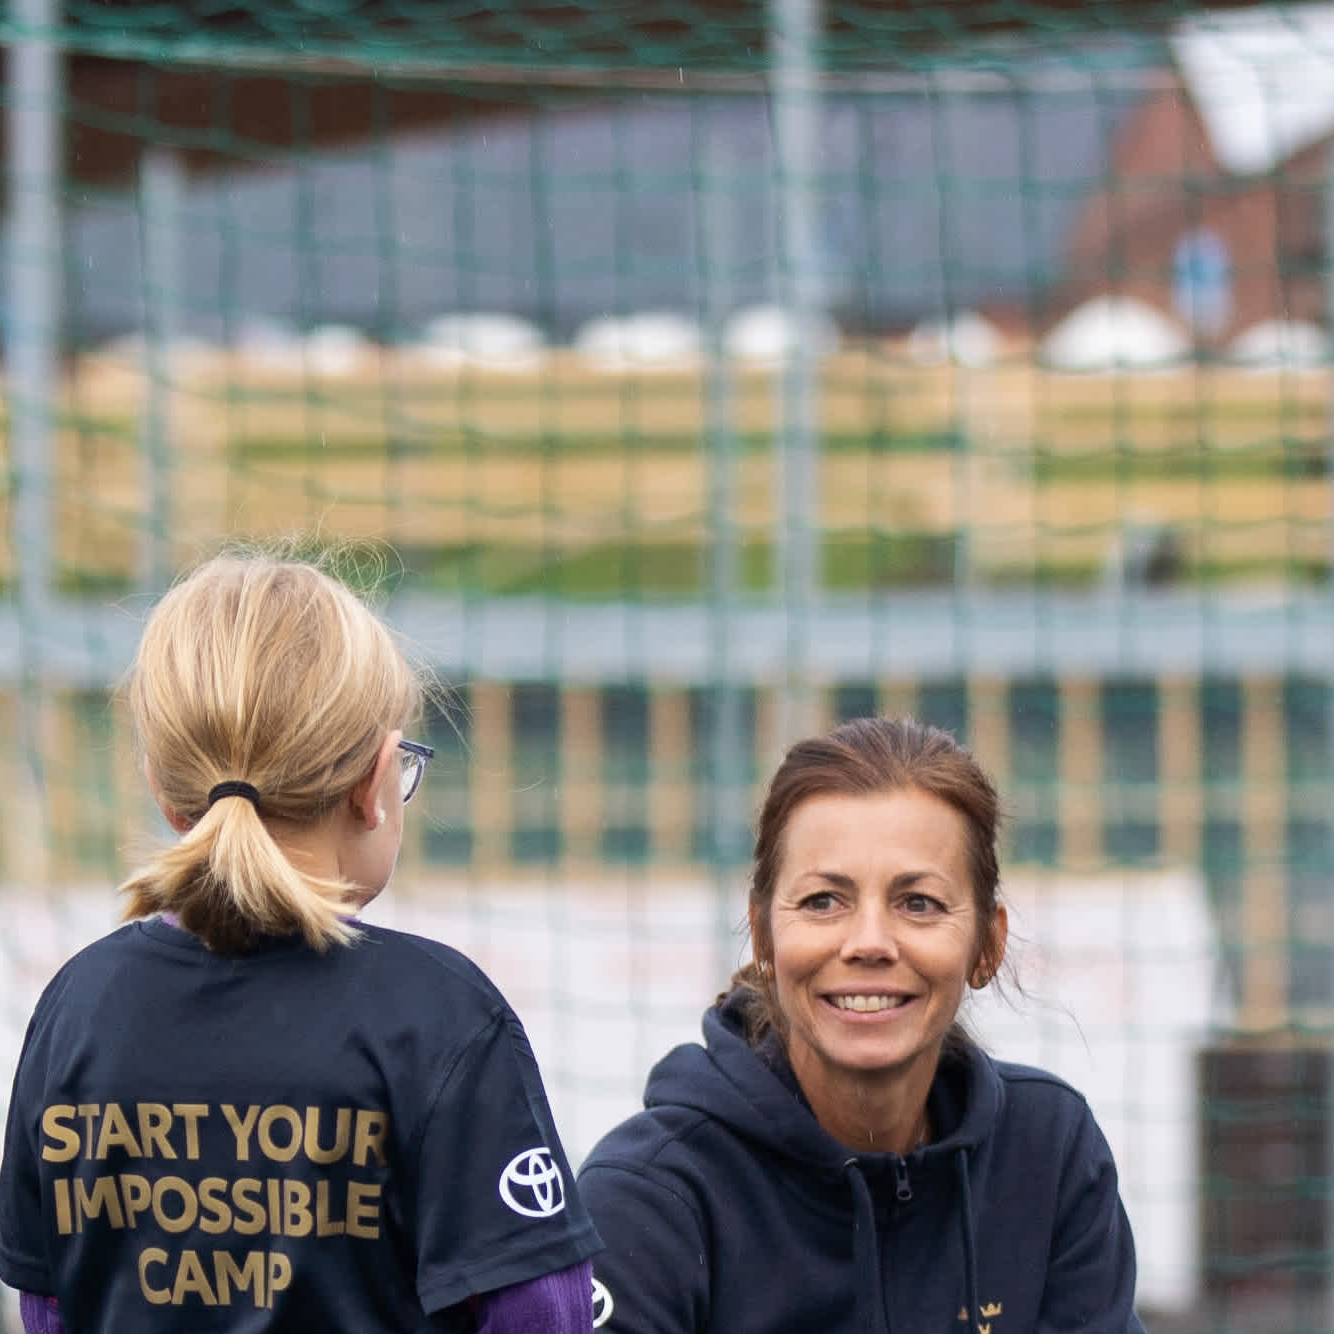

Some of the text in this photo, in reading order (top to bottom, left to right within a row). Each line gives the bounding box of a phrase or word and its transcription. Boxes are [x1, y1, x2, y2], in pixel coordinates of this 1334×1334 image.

[41, 1103, 387, 1167] START YOUR
[53, 1174, 382, 1239] IMPOSSIBLE
[138, 1247, 292, 1309] CAMP
